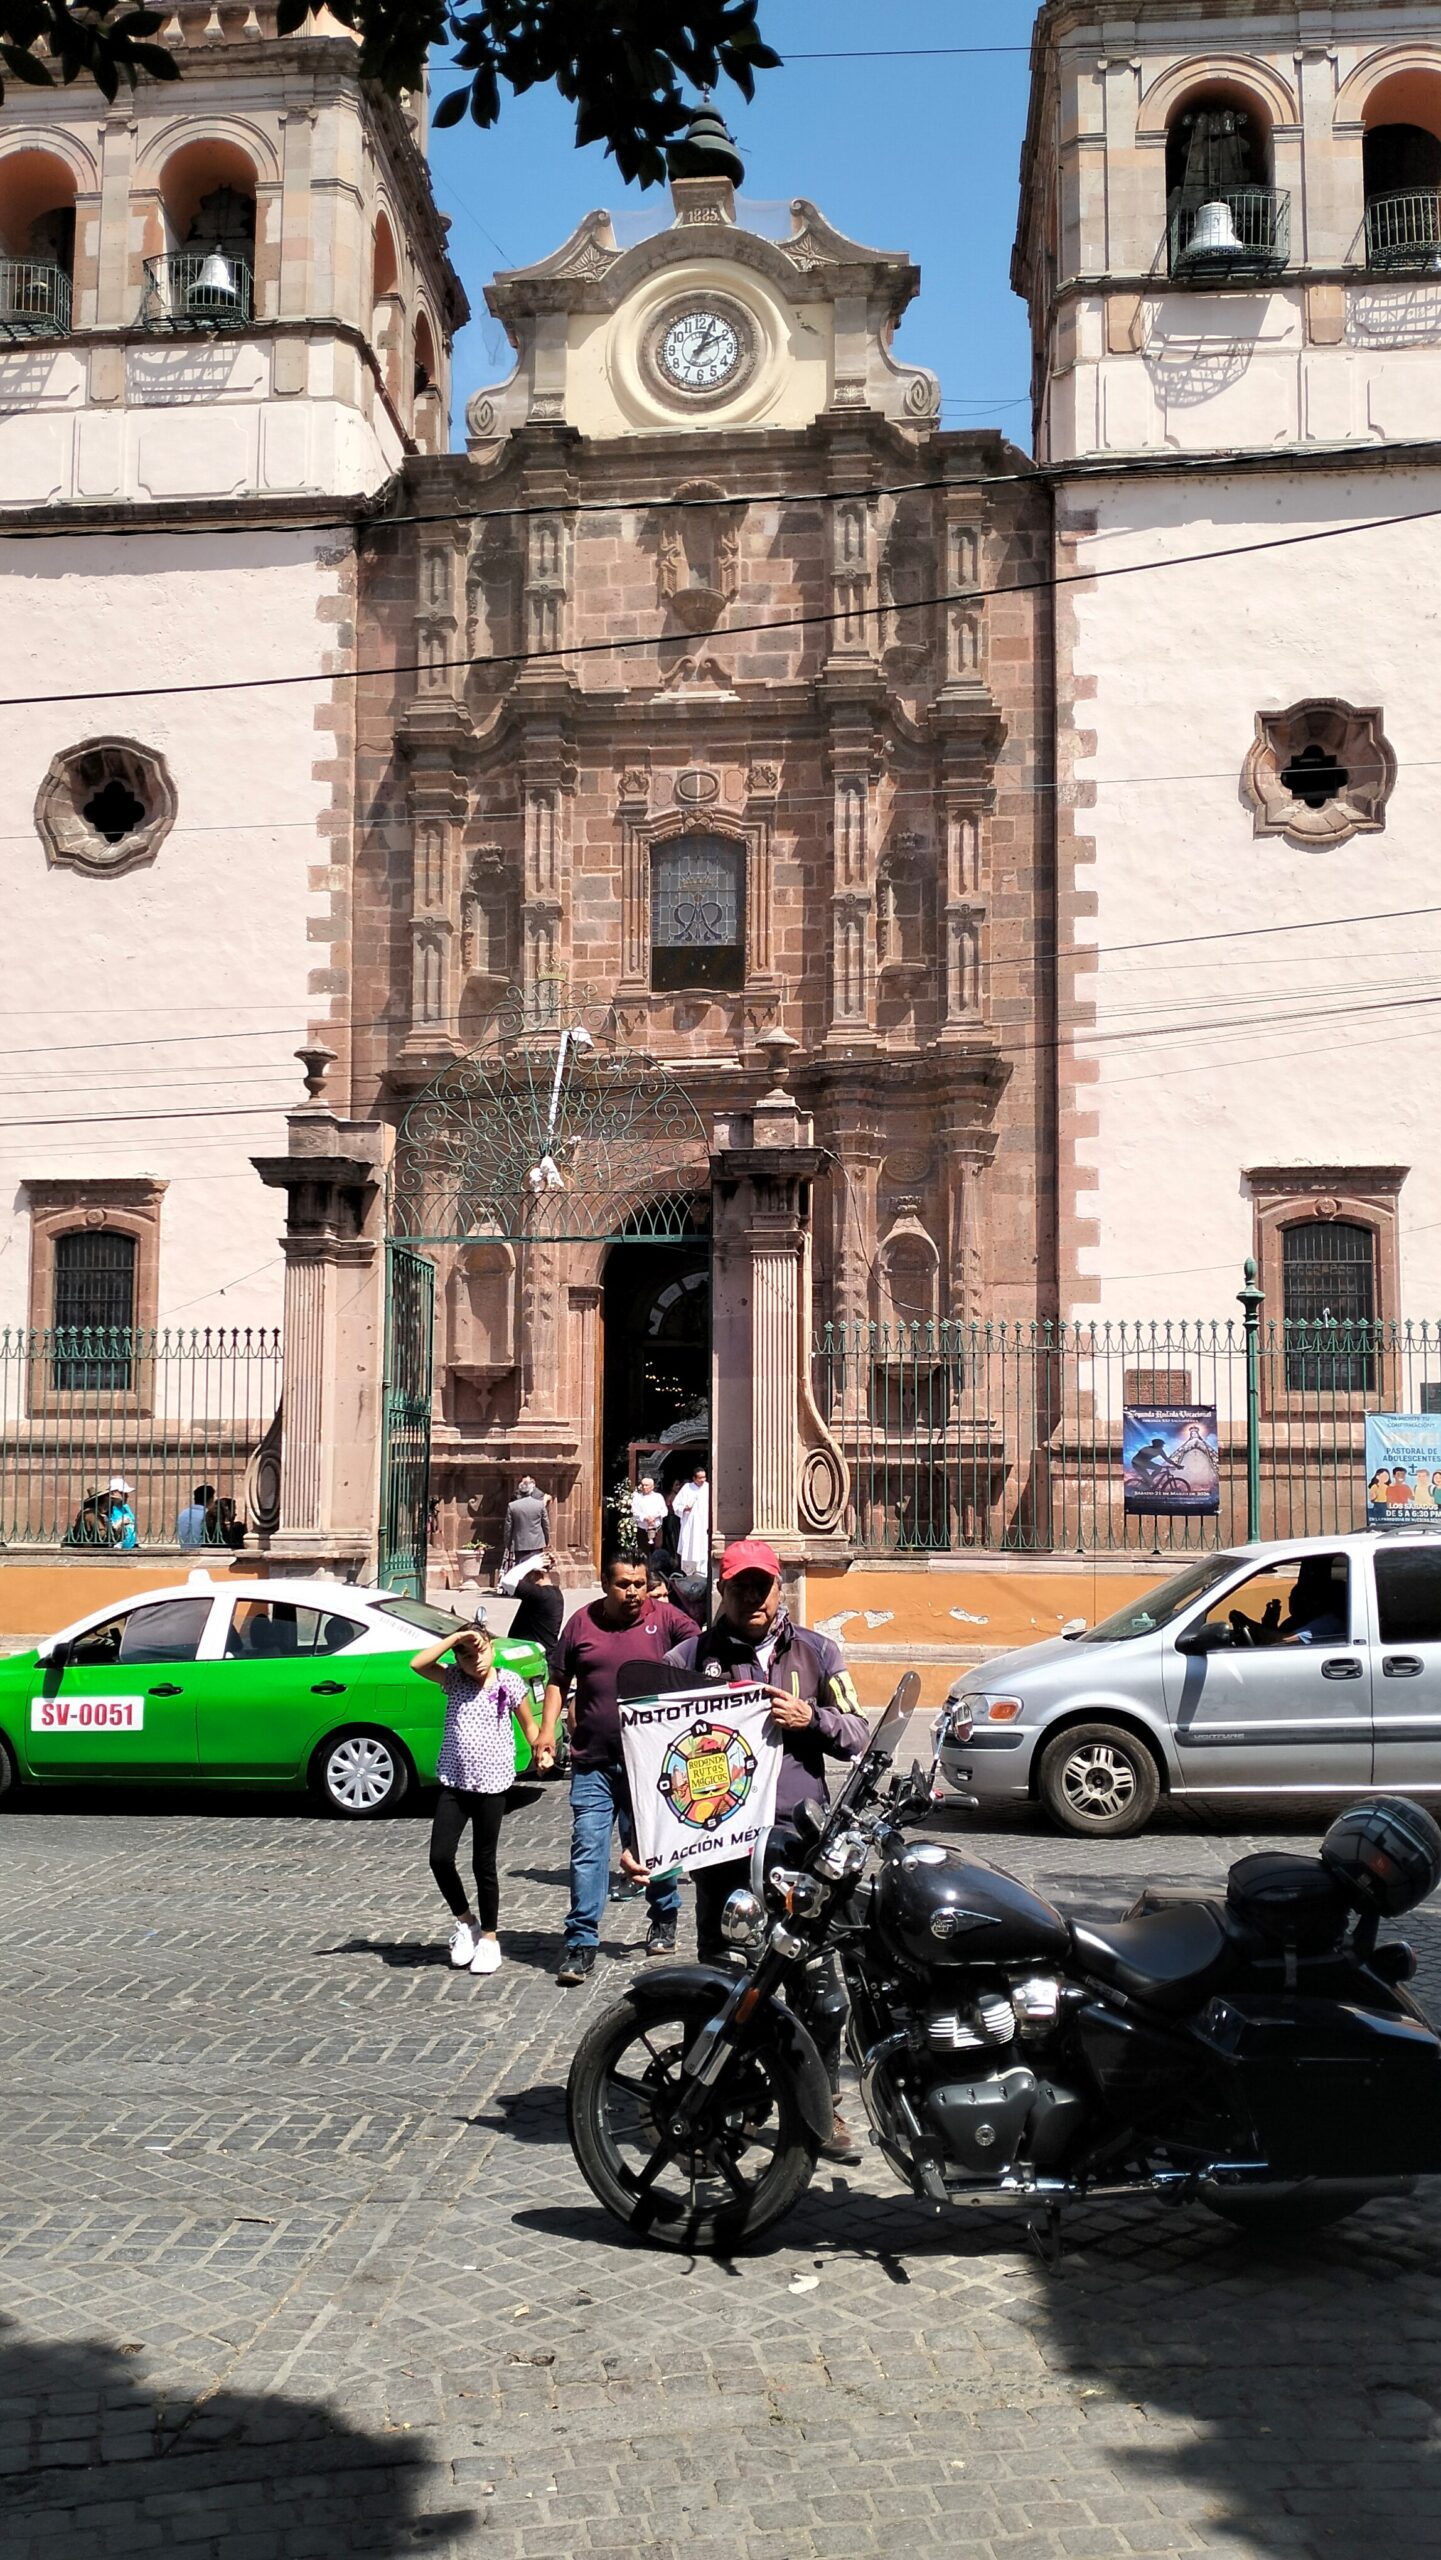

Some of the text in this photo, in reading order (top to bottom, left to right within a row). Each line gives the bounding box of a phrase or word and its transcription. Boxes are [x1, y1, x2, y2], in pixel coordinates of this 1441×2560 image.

[684, 322, 692, 333] 11
[695, 318, 706, 330] 12
[673, 331, 684, 343] 10
[722, 329, 729, 341] 2
[668, 345, 675, 356] 9
[726, 342, 733, 354] 3
[673, 358, 679, 369] 8
[720, 355, 728, 366] 4
[683, 366, 690, 378] 7
[697, 369, 704, 380] 6
[710, 365, 717, 377] 5
[1383, 1454, 1441, 1462] ADOLESCENTES
[1412, 1510, 1429, 1518] 6:30
[41, 1703, 132, 1726] SV-0051
[696, 1724, 707, 1734] N
[746, 1760, 755, 1769] E
[660, 1780, 671, 1790] O
[707, 1819, 717, 1827] S
[645, 1826, 762, 1870] EN ACCIÓN MÉX
